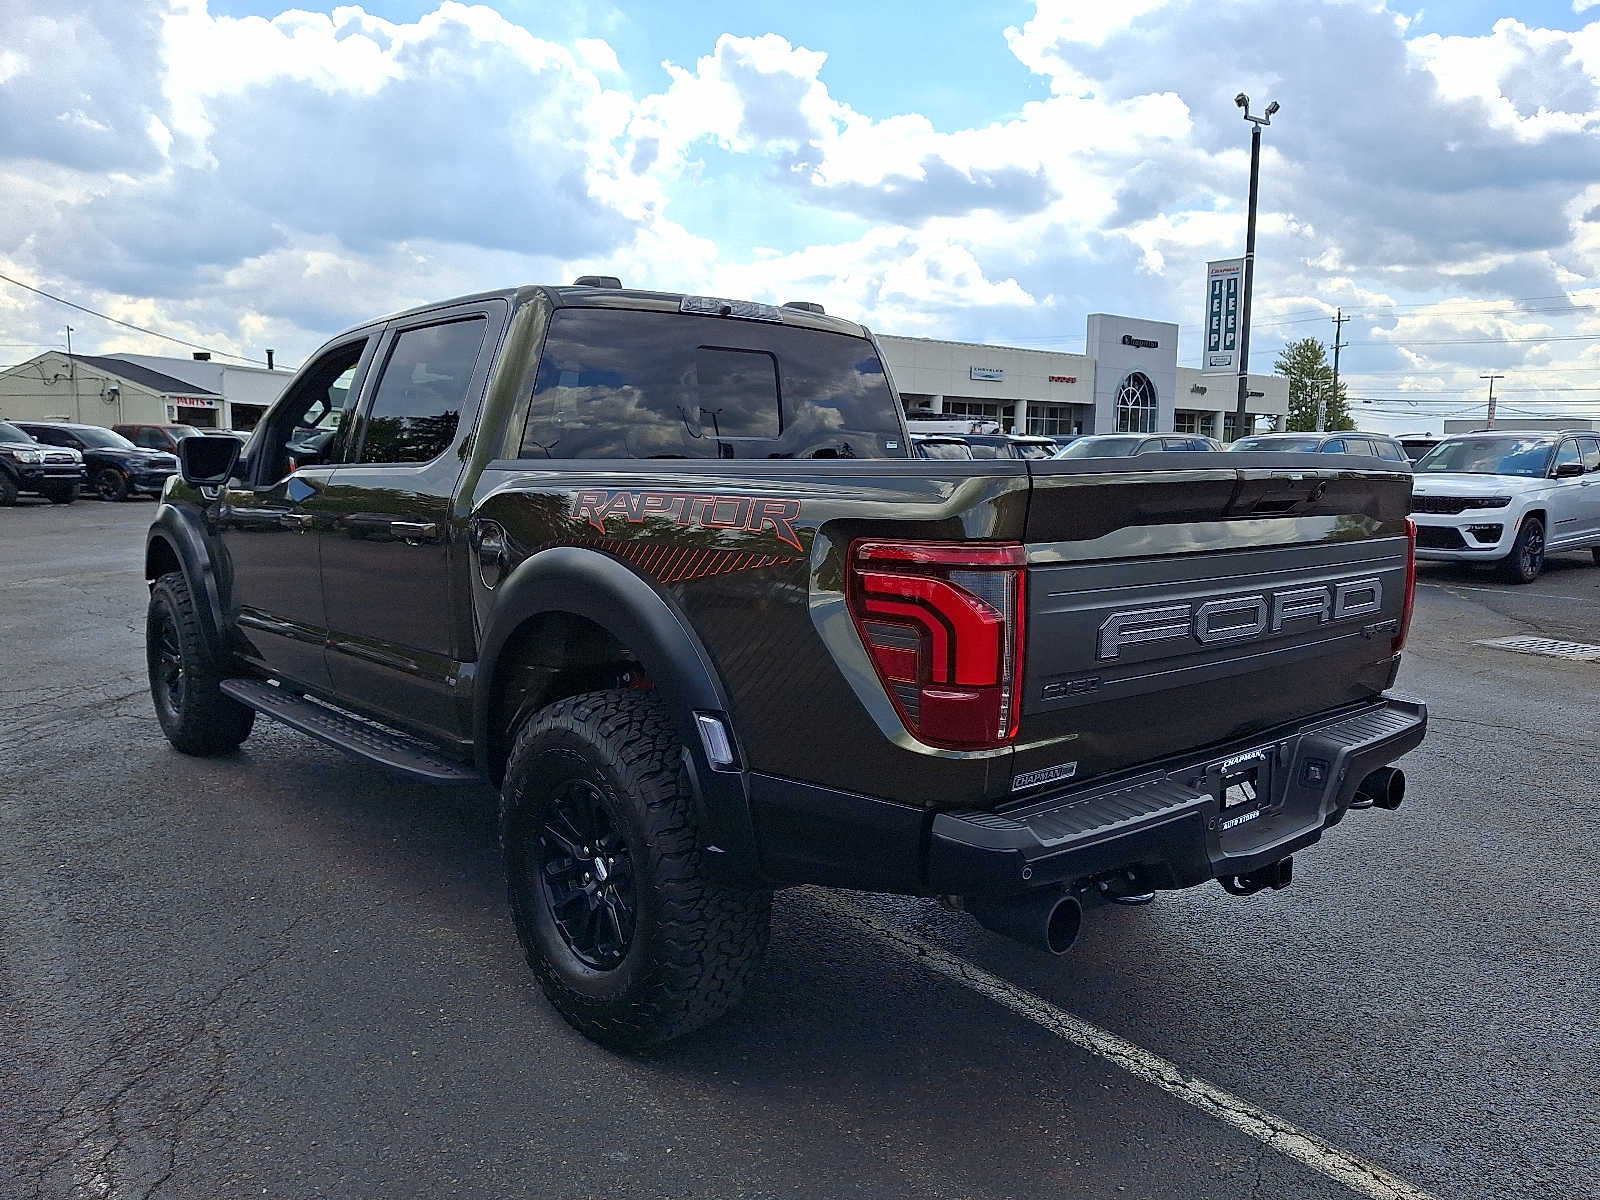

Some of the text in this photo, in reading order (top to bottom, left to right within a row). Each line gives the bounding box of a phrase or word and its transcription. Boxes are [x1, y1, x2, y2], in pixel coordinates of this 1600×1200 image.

[1210, 281, 1221, 348] JEEP
[1225, 279, 1237, 347] JEEP
[176, 397, 206, 407] PARTS
[570, 490, 804, 553] RAPTOR
[1095, 576, 1384, 662] FORD
[1015, 769, 1062, 787] CHAPMAN
[1224, 750, 1262, 768] CHAPMAN
[1223, 810, 1260, 830] AUTO STORES
